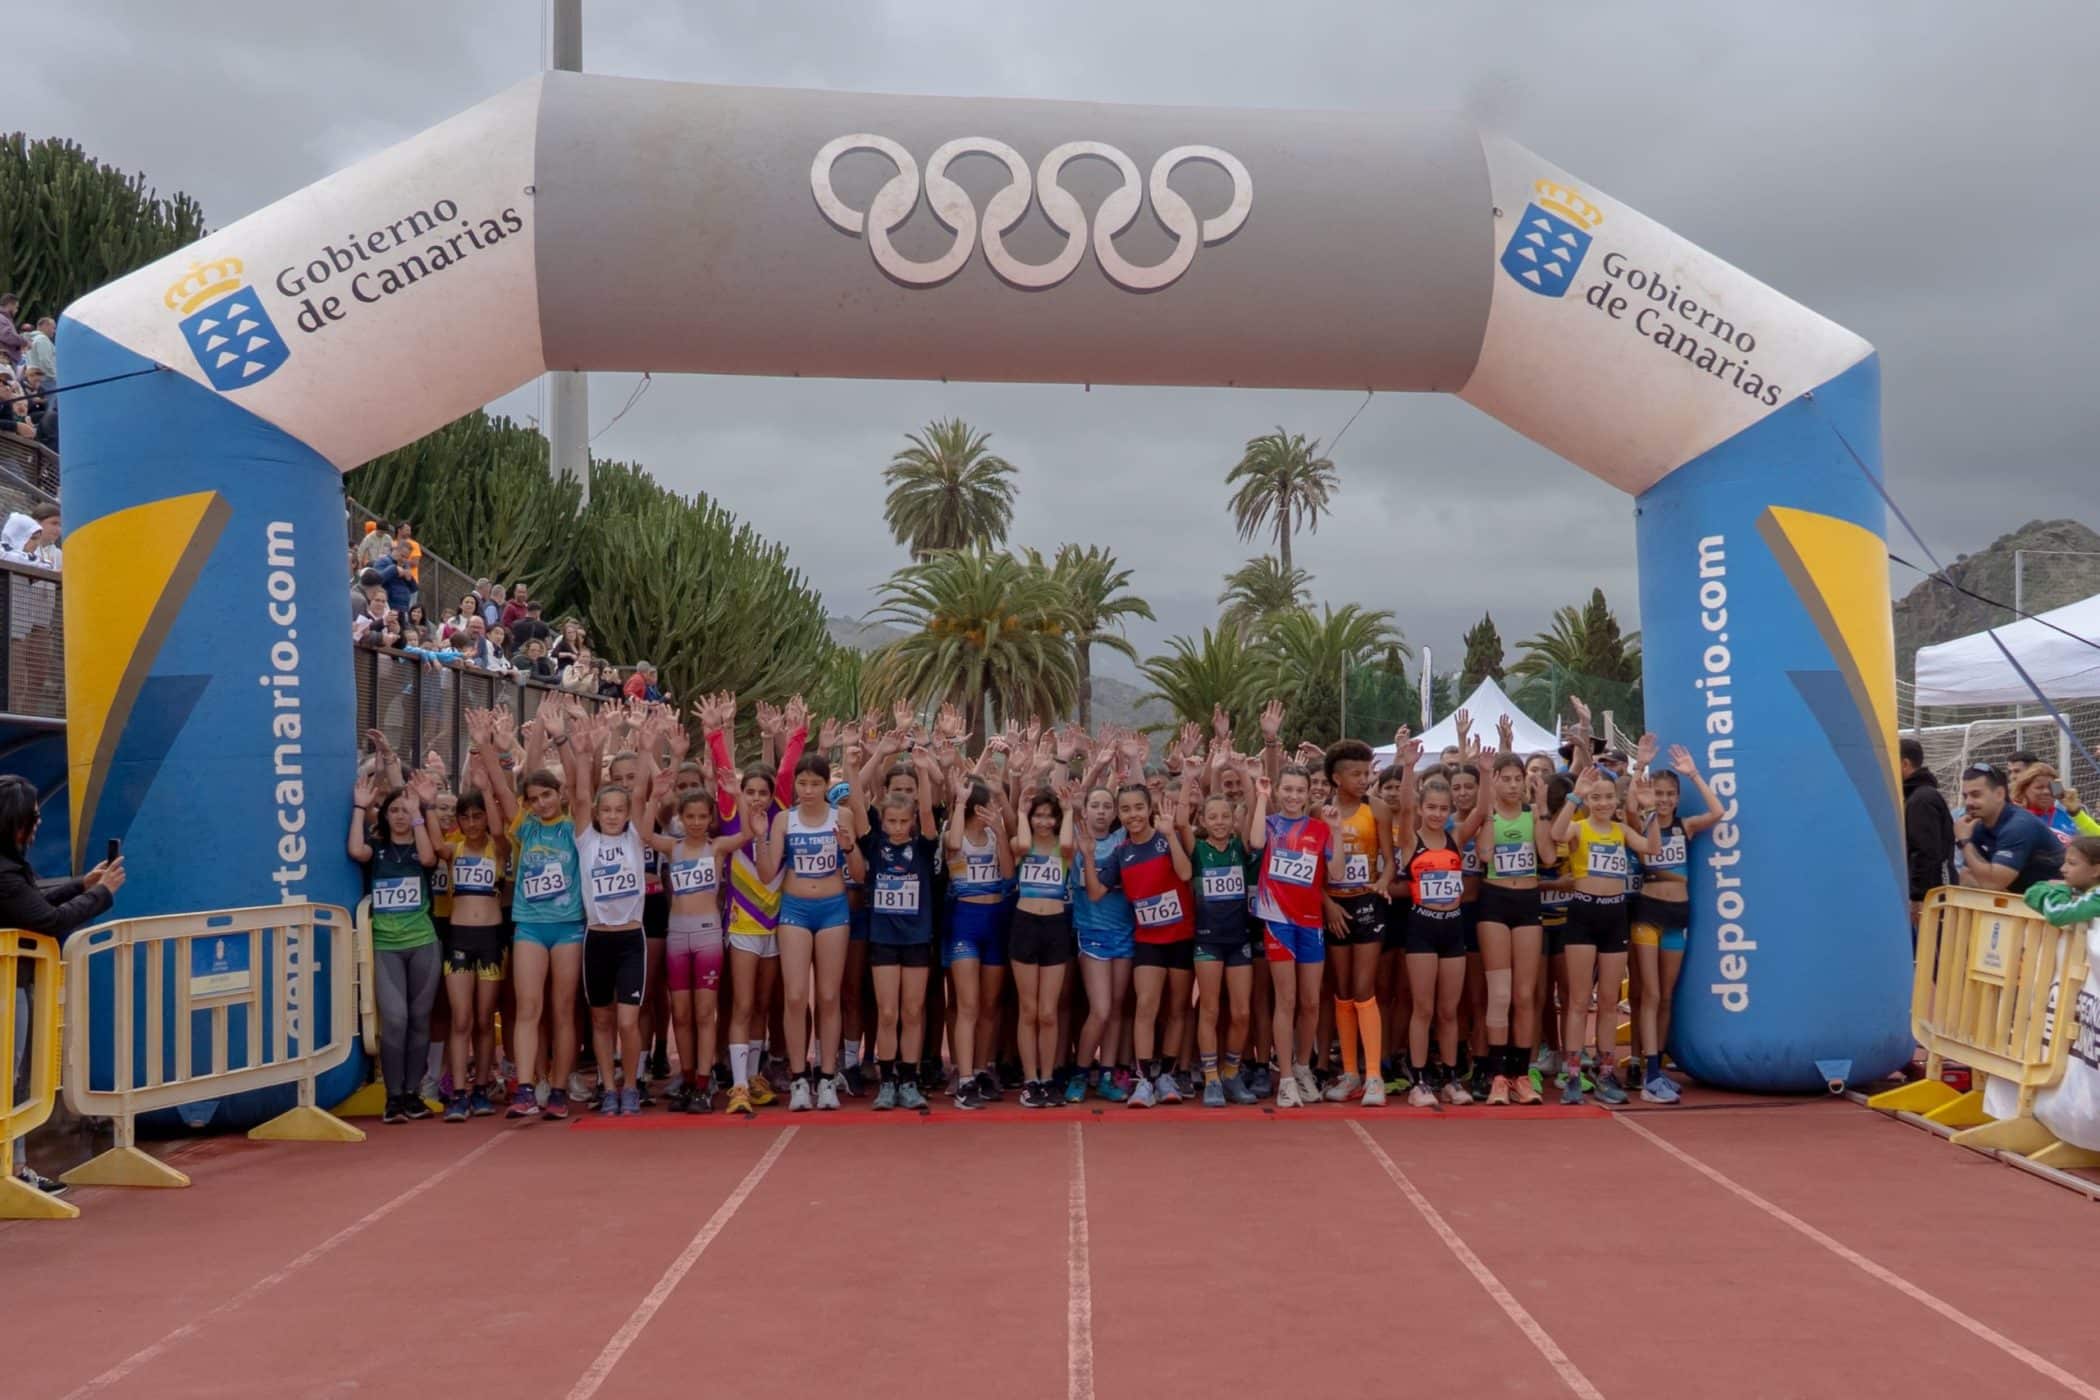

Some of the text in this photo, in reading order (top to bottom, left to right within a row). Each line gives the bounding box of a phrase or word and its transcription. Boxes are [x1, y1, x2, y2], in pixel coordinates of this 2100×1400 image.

[275, 198, 459, 299] Gobierno
[295, 206, 525, 334] de Canarias
[1602, 250, 1757, 354] Gobierno
[1585, 280, 1783, 407] de Canarias
[1695, 534, 1757, 1013] deportecanario.com
[796, 854, 836, 870] 1790
[1271, 858, 1314, 880] 1722
[1495, 853, 1535, 870] 1753
[1591, 854, 1626, 871] 1759
[454, 866, 494, 884] 1750
[672, 868, 714, 888] 1798
[1022, 864, 1061, 882] 1740
[525, 874, 564, 895] 1733
[594, 873, 636, 894] 1729
[1205, 877, 1243, 894] 1809
[1422, 881, 1462, 897] 1754
[375, 887, 419, 906] 1792
[877, 891, 915, 907] 1811
[1137, 900, 1180, 923] 1762
[1416, 907, 1445, 920] NIKE
